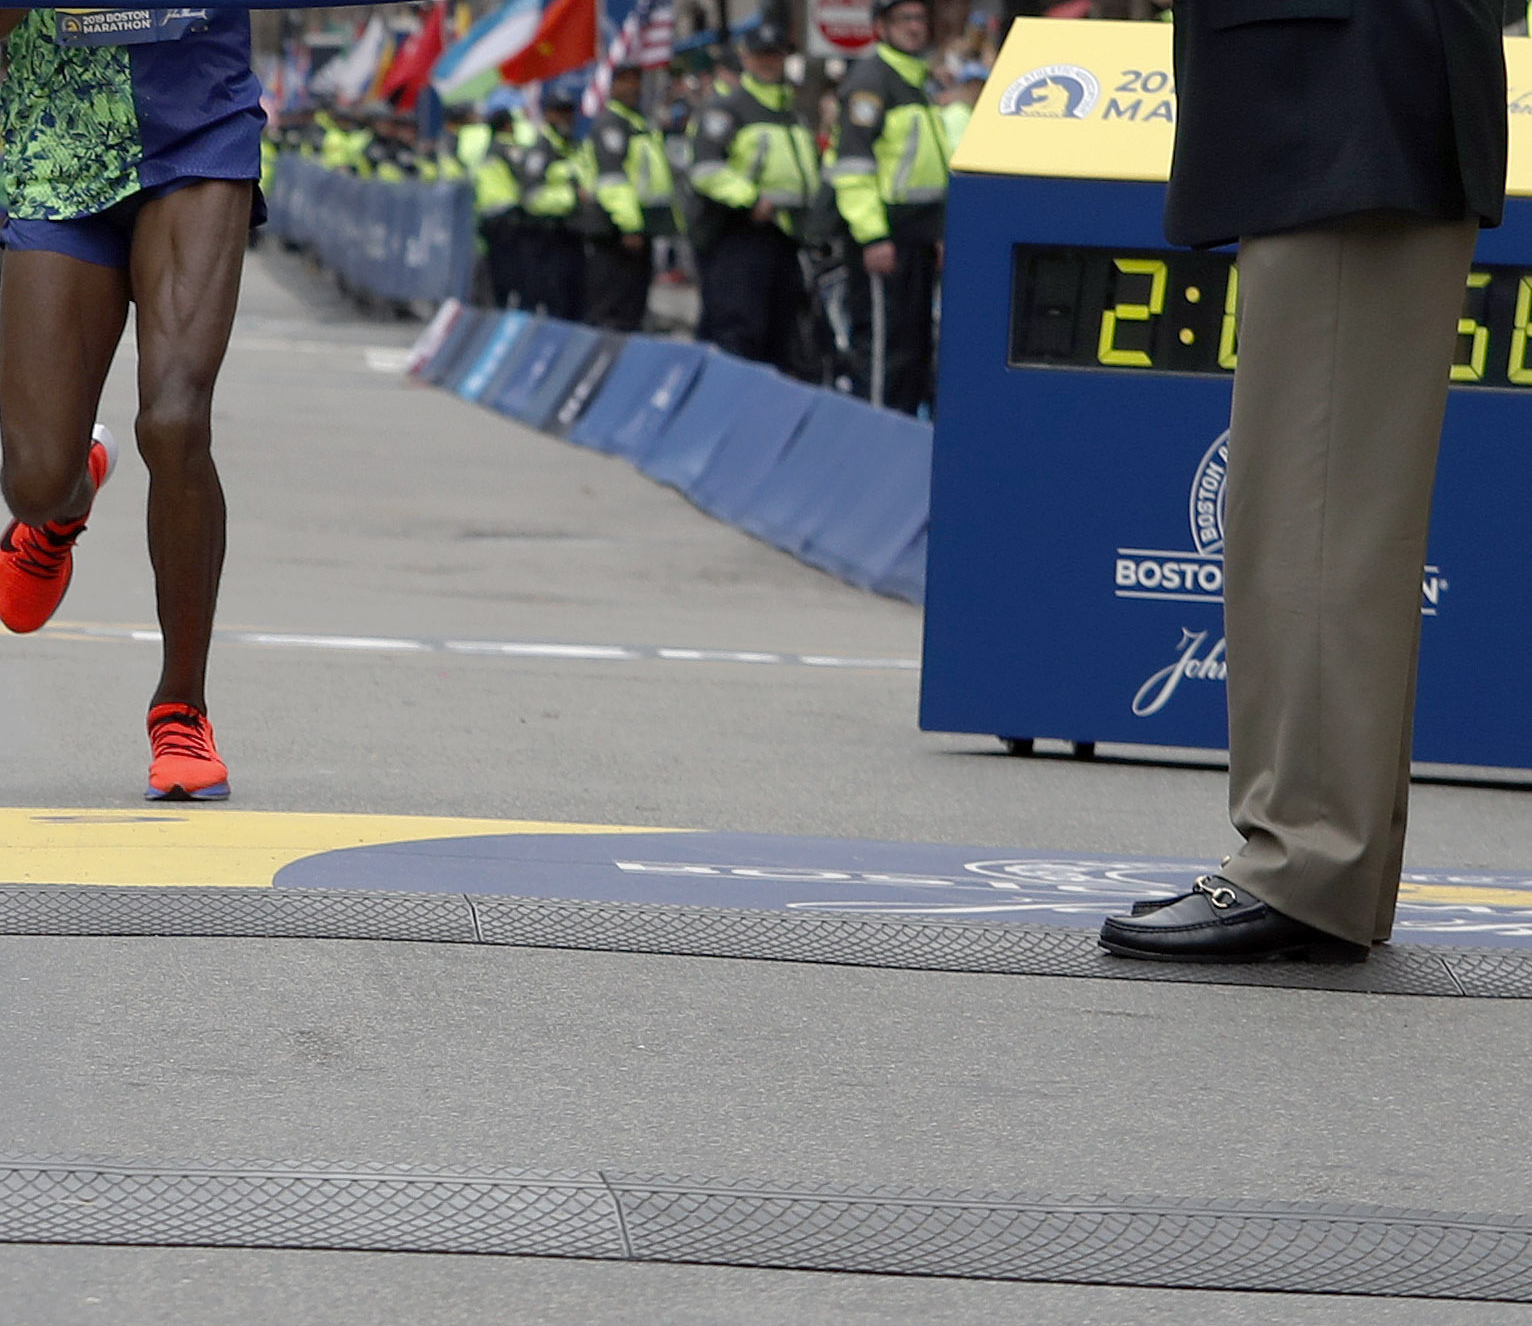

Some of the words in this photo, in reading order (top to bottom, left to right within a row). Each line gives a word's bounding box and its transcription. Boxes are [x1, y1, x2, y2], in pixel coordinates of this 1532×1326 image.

[83, 19, 151, 34] MARATHON
[106, 9, 150, 23] BOSTON
[1198, 461, 1224, 545] BOSTON
[1115, 558, 1224, 592] BOSTO
